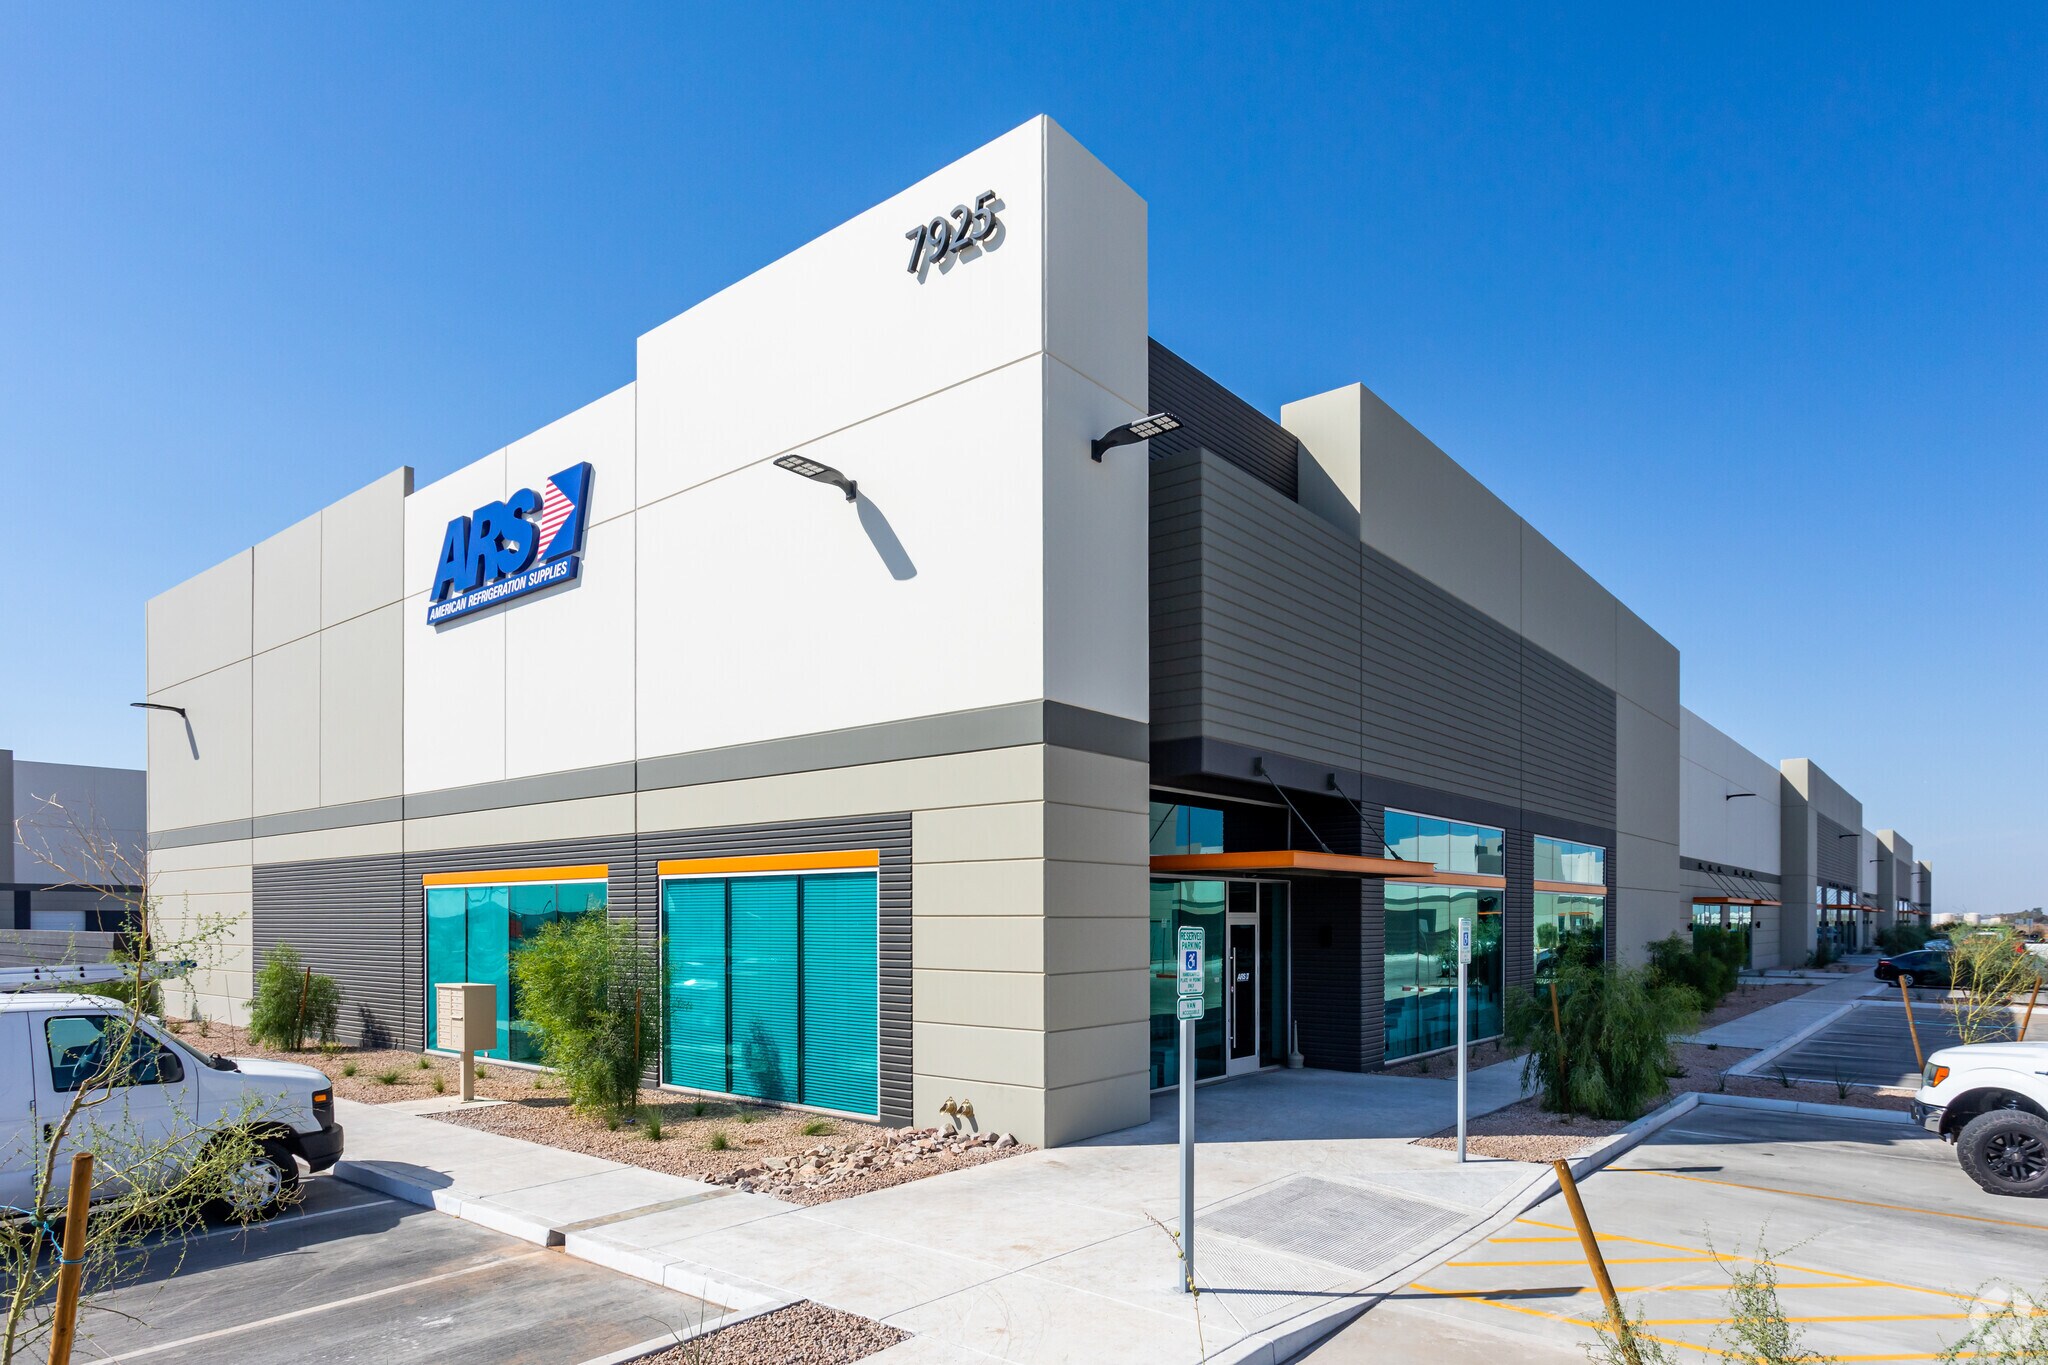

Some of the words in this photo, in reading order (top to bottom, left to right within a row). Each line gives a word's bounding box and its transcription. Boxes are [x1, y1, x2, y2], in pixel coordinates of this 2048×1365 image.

[905, 189, 997, 275] 7925
[430, 488, 544, 603] ARS
[429, 597, 467, 621] AMERICAN
[468, 574, 527, 608] REFRIGERATION
[528, 561, 568, 585] SUPPLIES
[1181, 931, 1202, 941] RESERVED
[1182, 941, 1202, 950] PARKING
